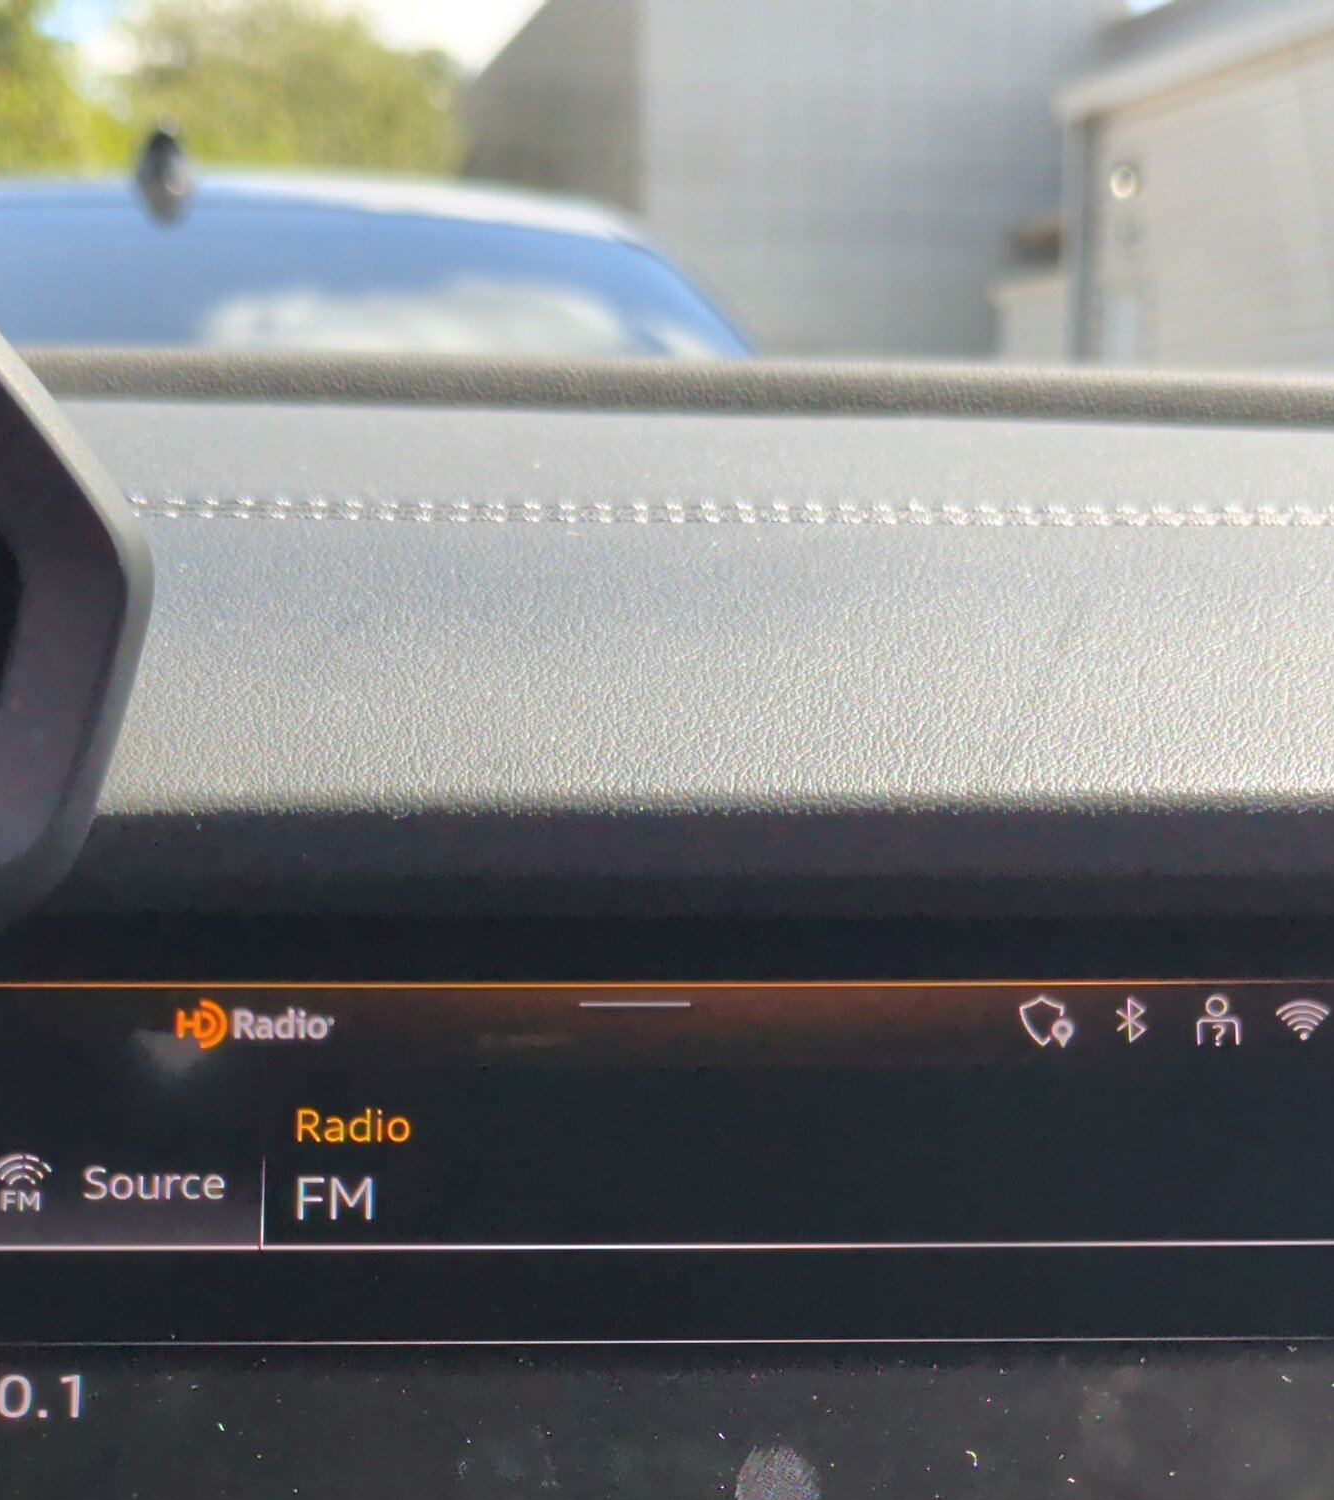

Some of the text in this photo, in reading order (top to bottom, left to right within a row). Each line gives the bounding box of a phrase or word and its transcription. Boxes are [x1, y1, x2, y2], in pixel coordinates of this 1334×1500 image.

[295, 1108, 411, 1144] Radio
[0, 1190, 42, 1213] FM
[83, 1165, 226, 1202] Source
[295, 1176, 374, 1221] FM
